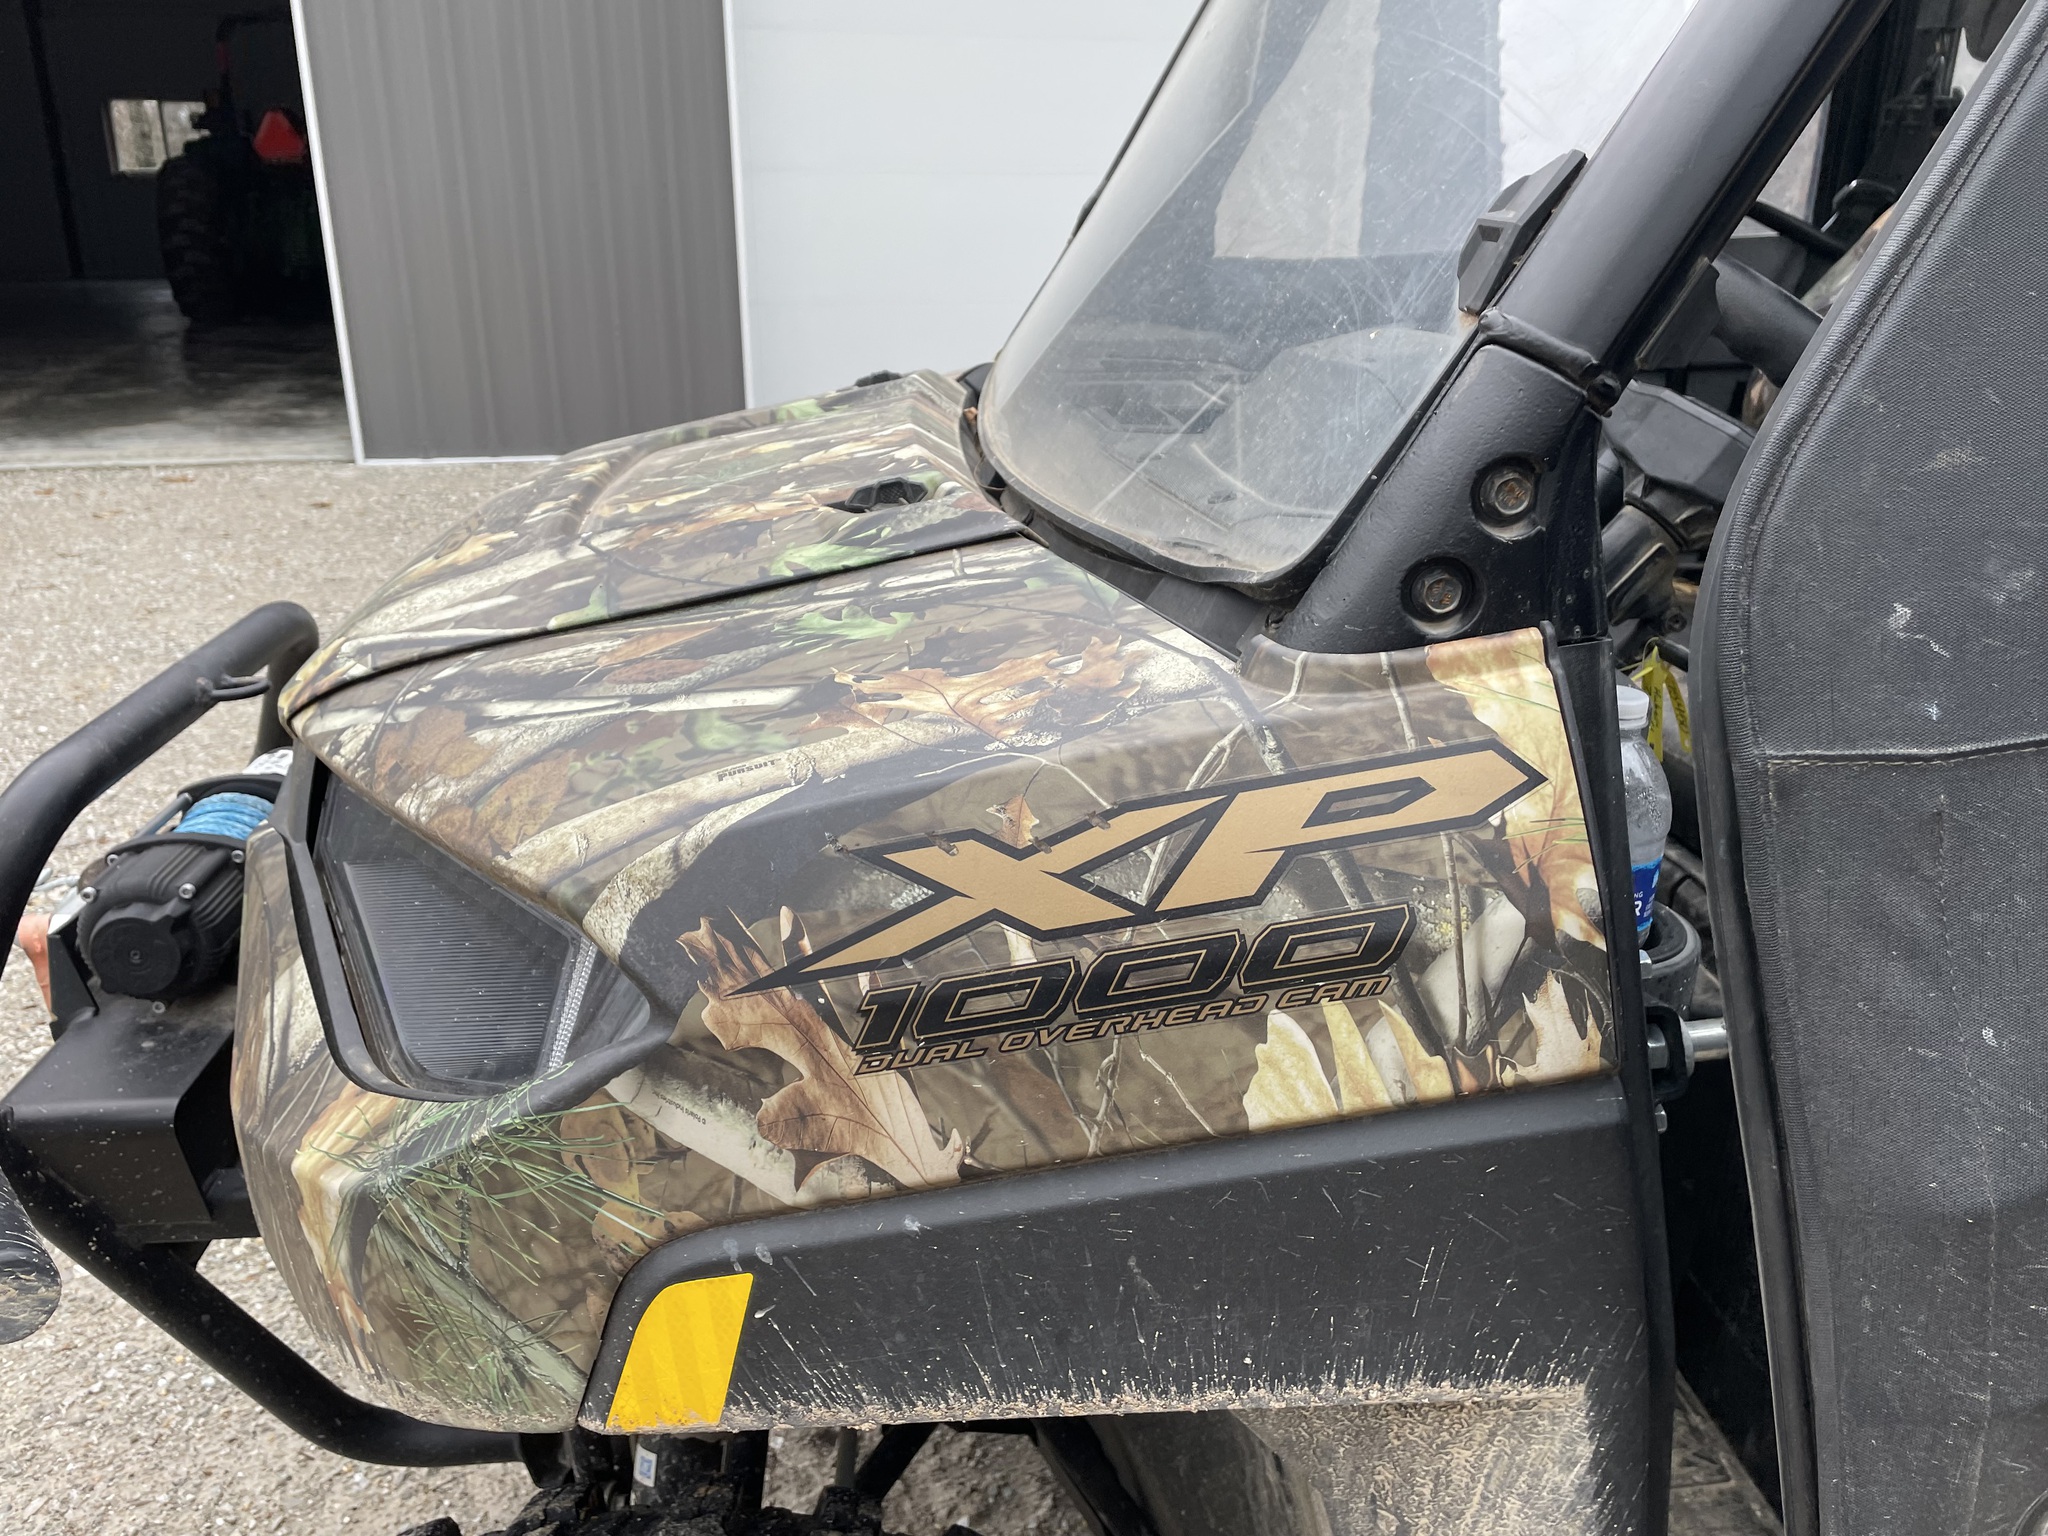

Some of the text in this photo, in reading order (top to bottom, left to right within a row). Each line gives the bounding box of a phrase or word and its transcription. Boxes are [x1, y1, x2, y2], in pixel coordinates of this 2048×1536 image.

[717, 760, 775, 782] PURSUIT
[728, 739, 1549, 997] XP
[852, 903, 1418, 1054] 1000
[853, 974, 1393, 1076] DUAL OVERHEAD CAM
